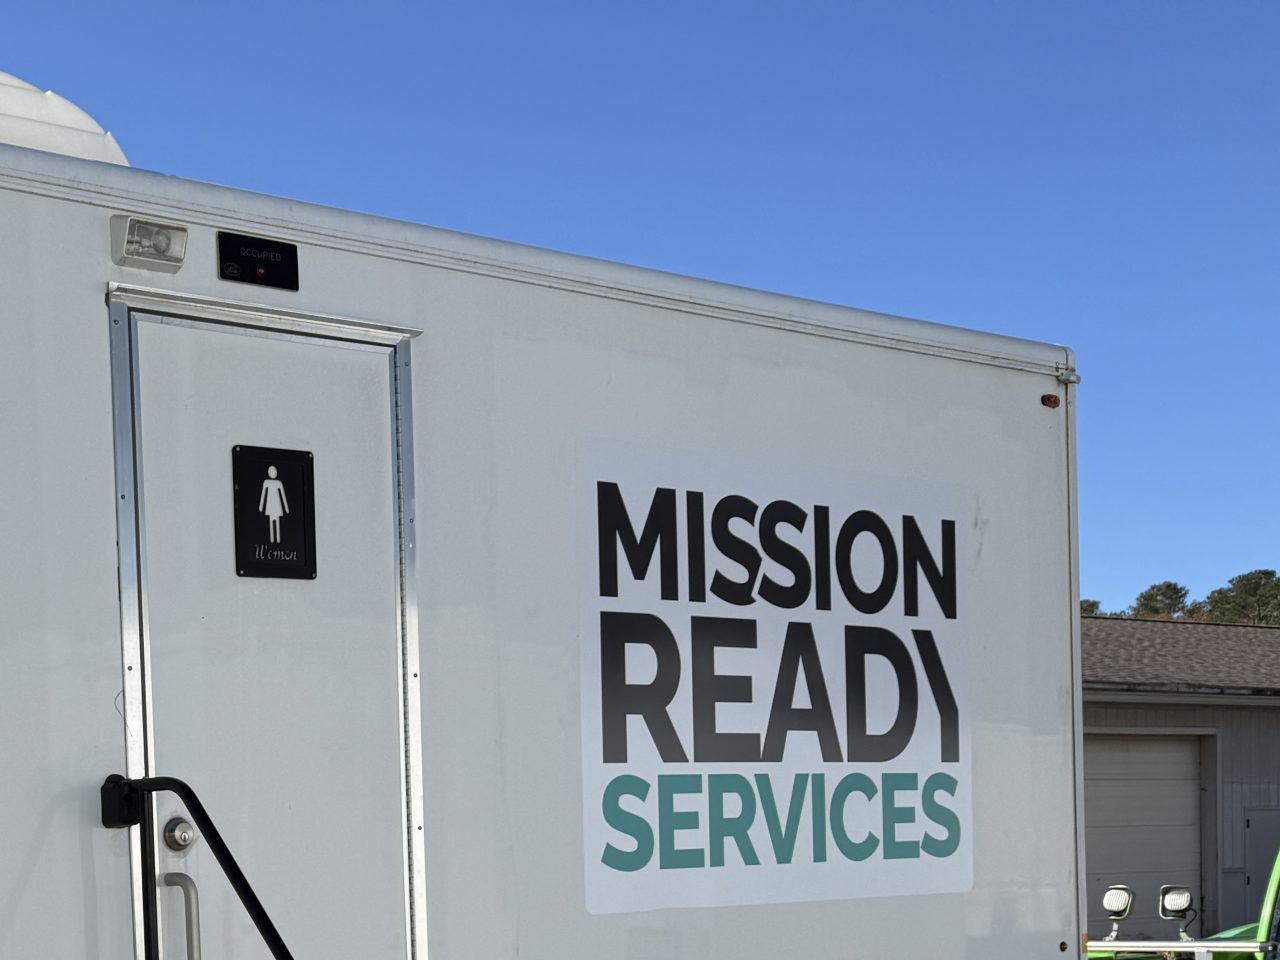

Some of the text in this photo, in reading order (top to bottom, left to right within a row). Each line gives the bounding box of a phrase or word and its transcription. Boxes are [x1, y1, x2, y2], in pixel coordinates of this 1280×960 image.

[239, 247, 282, 262] OCCUPIED
[254, 543, 297, 560] Women
[597, 480, 958, 620] MISSION
[600, 611, 960, 763] READY
[600, 772, 962, 872] SERVICES
